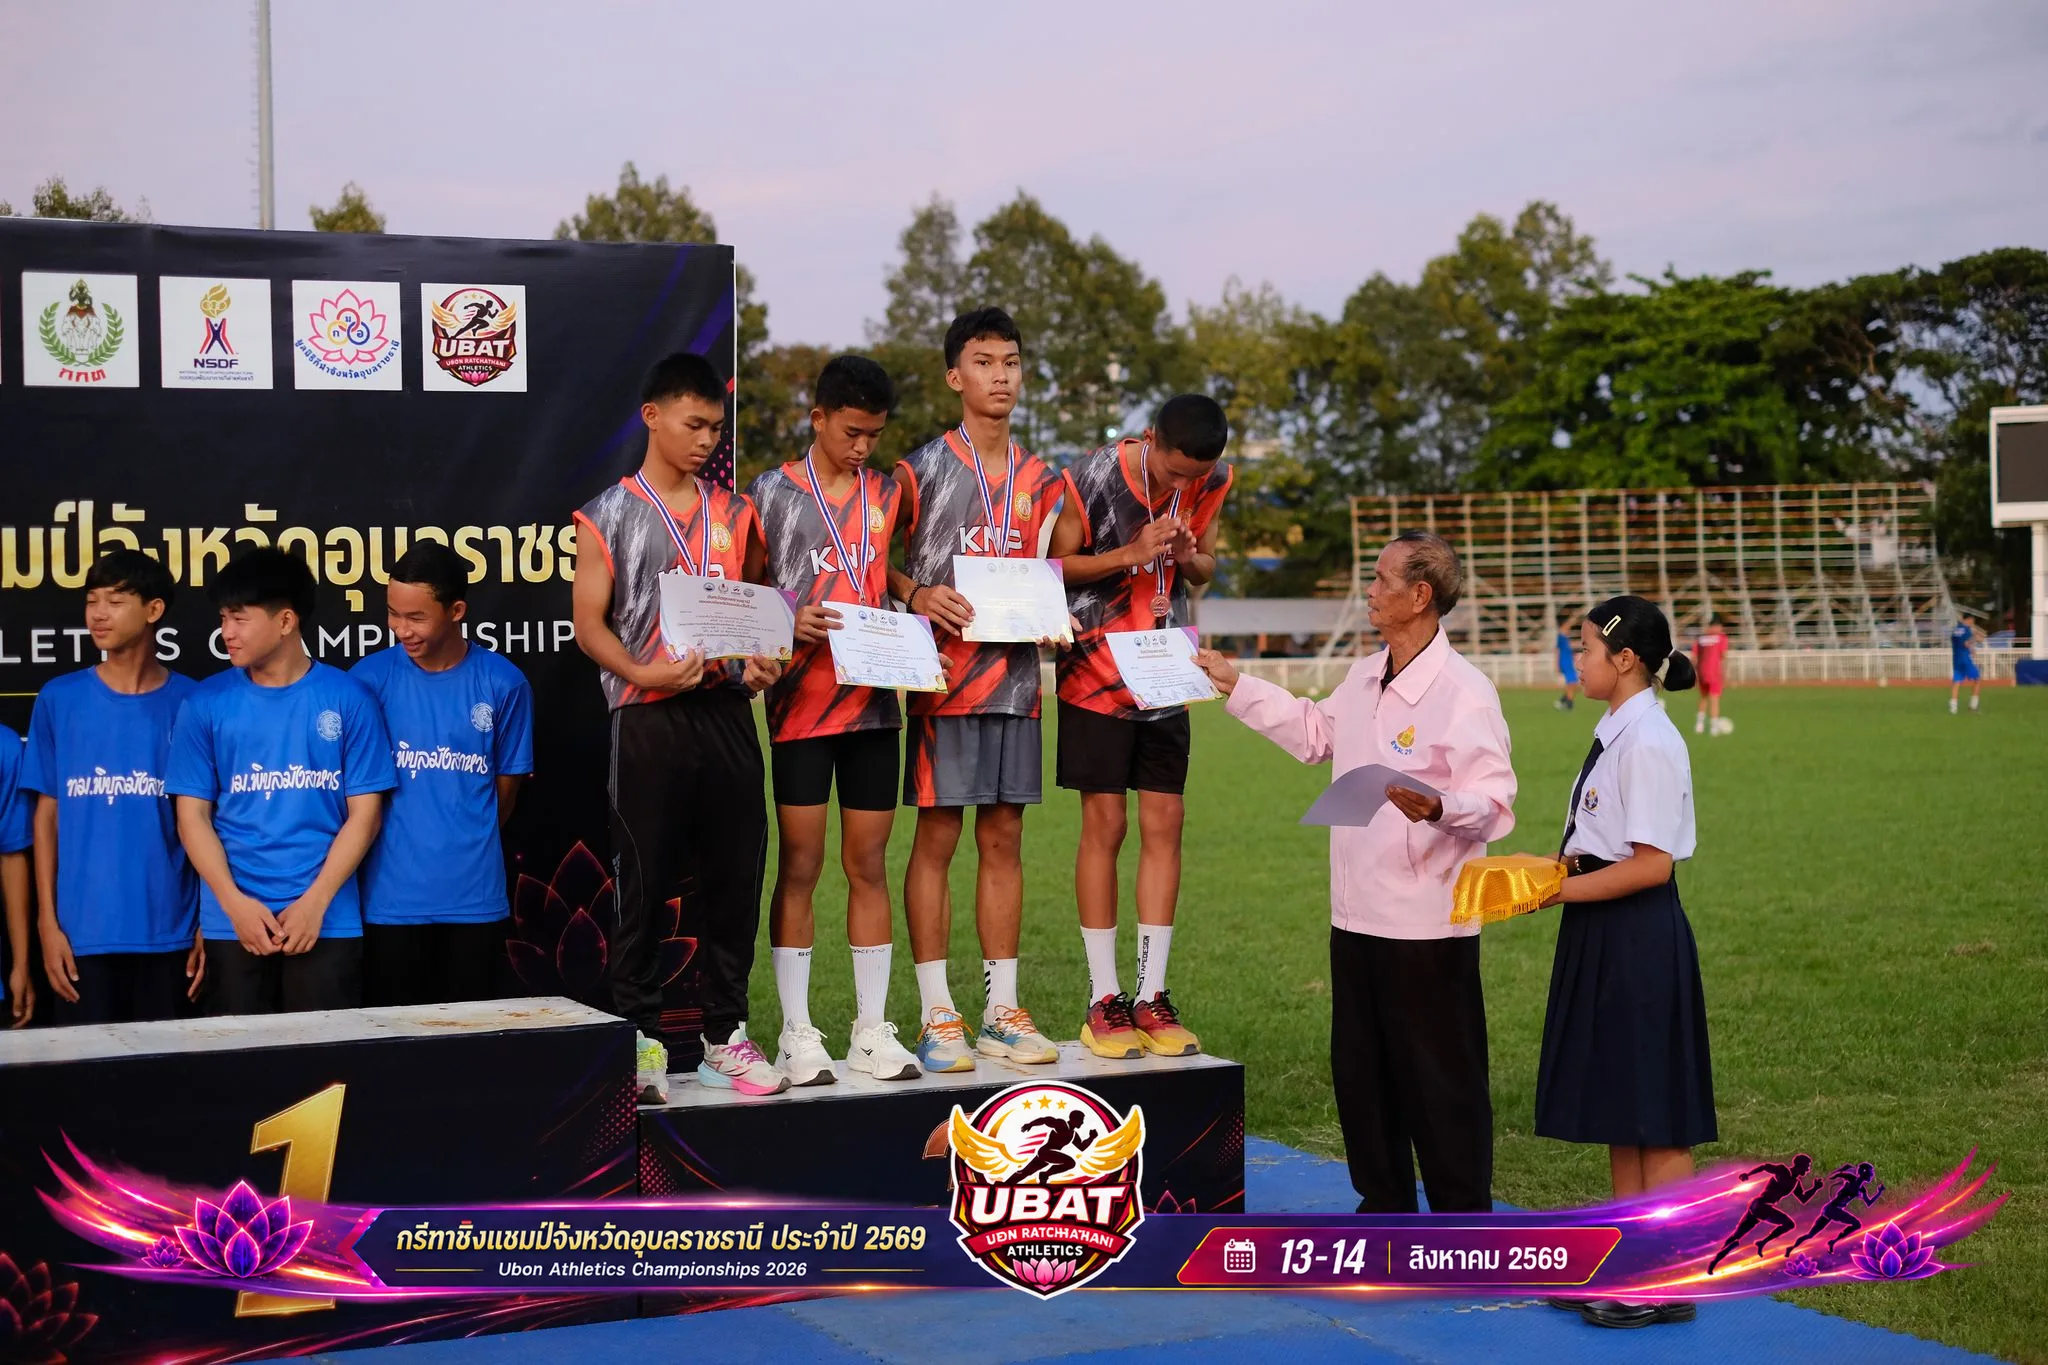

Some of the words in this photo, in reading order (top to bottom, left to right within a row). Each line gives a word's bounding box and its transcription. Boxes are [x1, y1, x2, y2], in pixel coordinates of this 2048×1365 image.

[440, 339, 510, 357] UBAT
[193, 358, 239, 369] NSDF
[58, 367, 107, 383] กกท
[235, 1084, 346, 1318] 1
